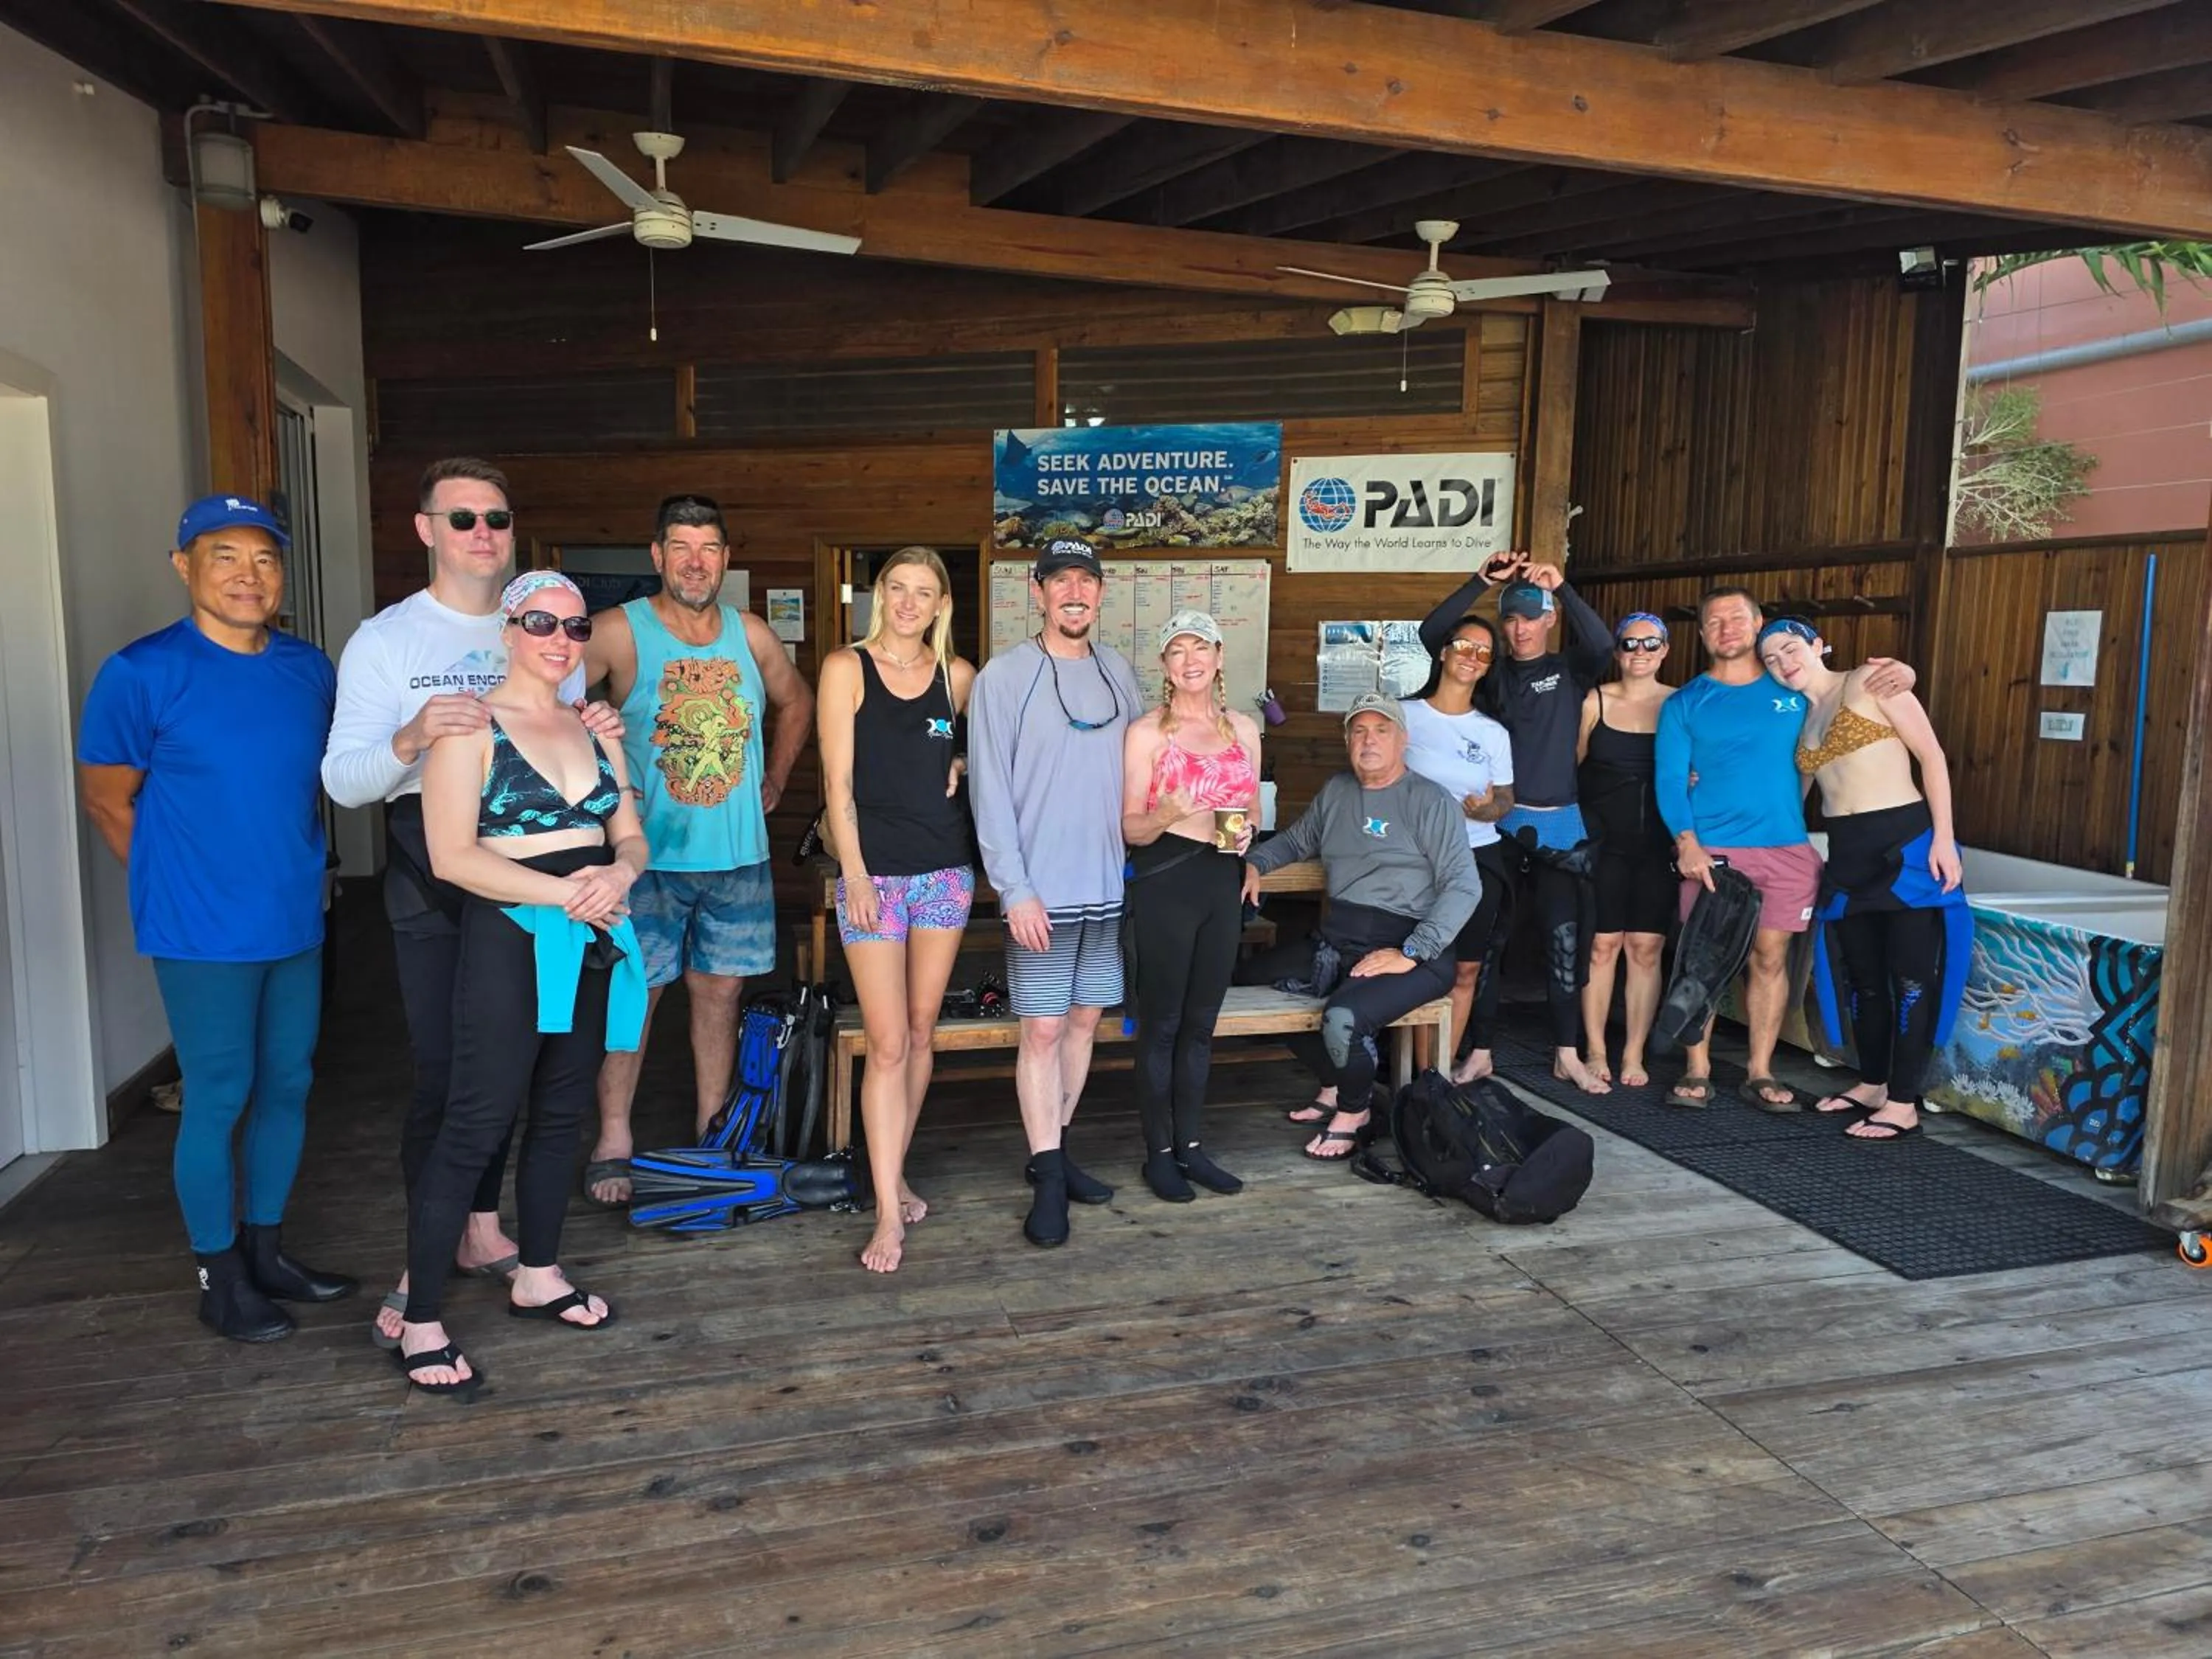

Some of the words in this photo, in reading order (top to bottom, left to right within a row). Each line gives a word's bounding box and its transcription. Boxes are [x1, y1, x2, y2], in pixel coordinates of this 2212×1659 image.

[1037, 454, 1090, 472] SEEK
[1097, 451, 1234, 471] ADVENTURE.
[1037, 477, 1090, 495] SAVE
[1097, 477, 1138, 494] THE
[1363, 478, 1496, 529] PADI
[1125, 512, 1162, 527] PADI
[1065, 541, 1092, 555] PADI
[1304, 537, 1322, 549] The
[1325, 537, 1352, 552] Way
[1354, 536, 1371, 549] the
[1374, 536, 1409, 549] World
[1412, 536, 1447, 549] Learns
[1451, 538, 1462, 549] to
[1465, 536, 1492, 548] Dive
[409, 674, 464, 689] OCEAN
